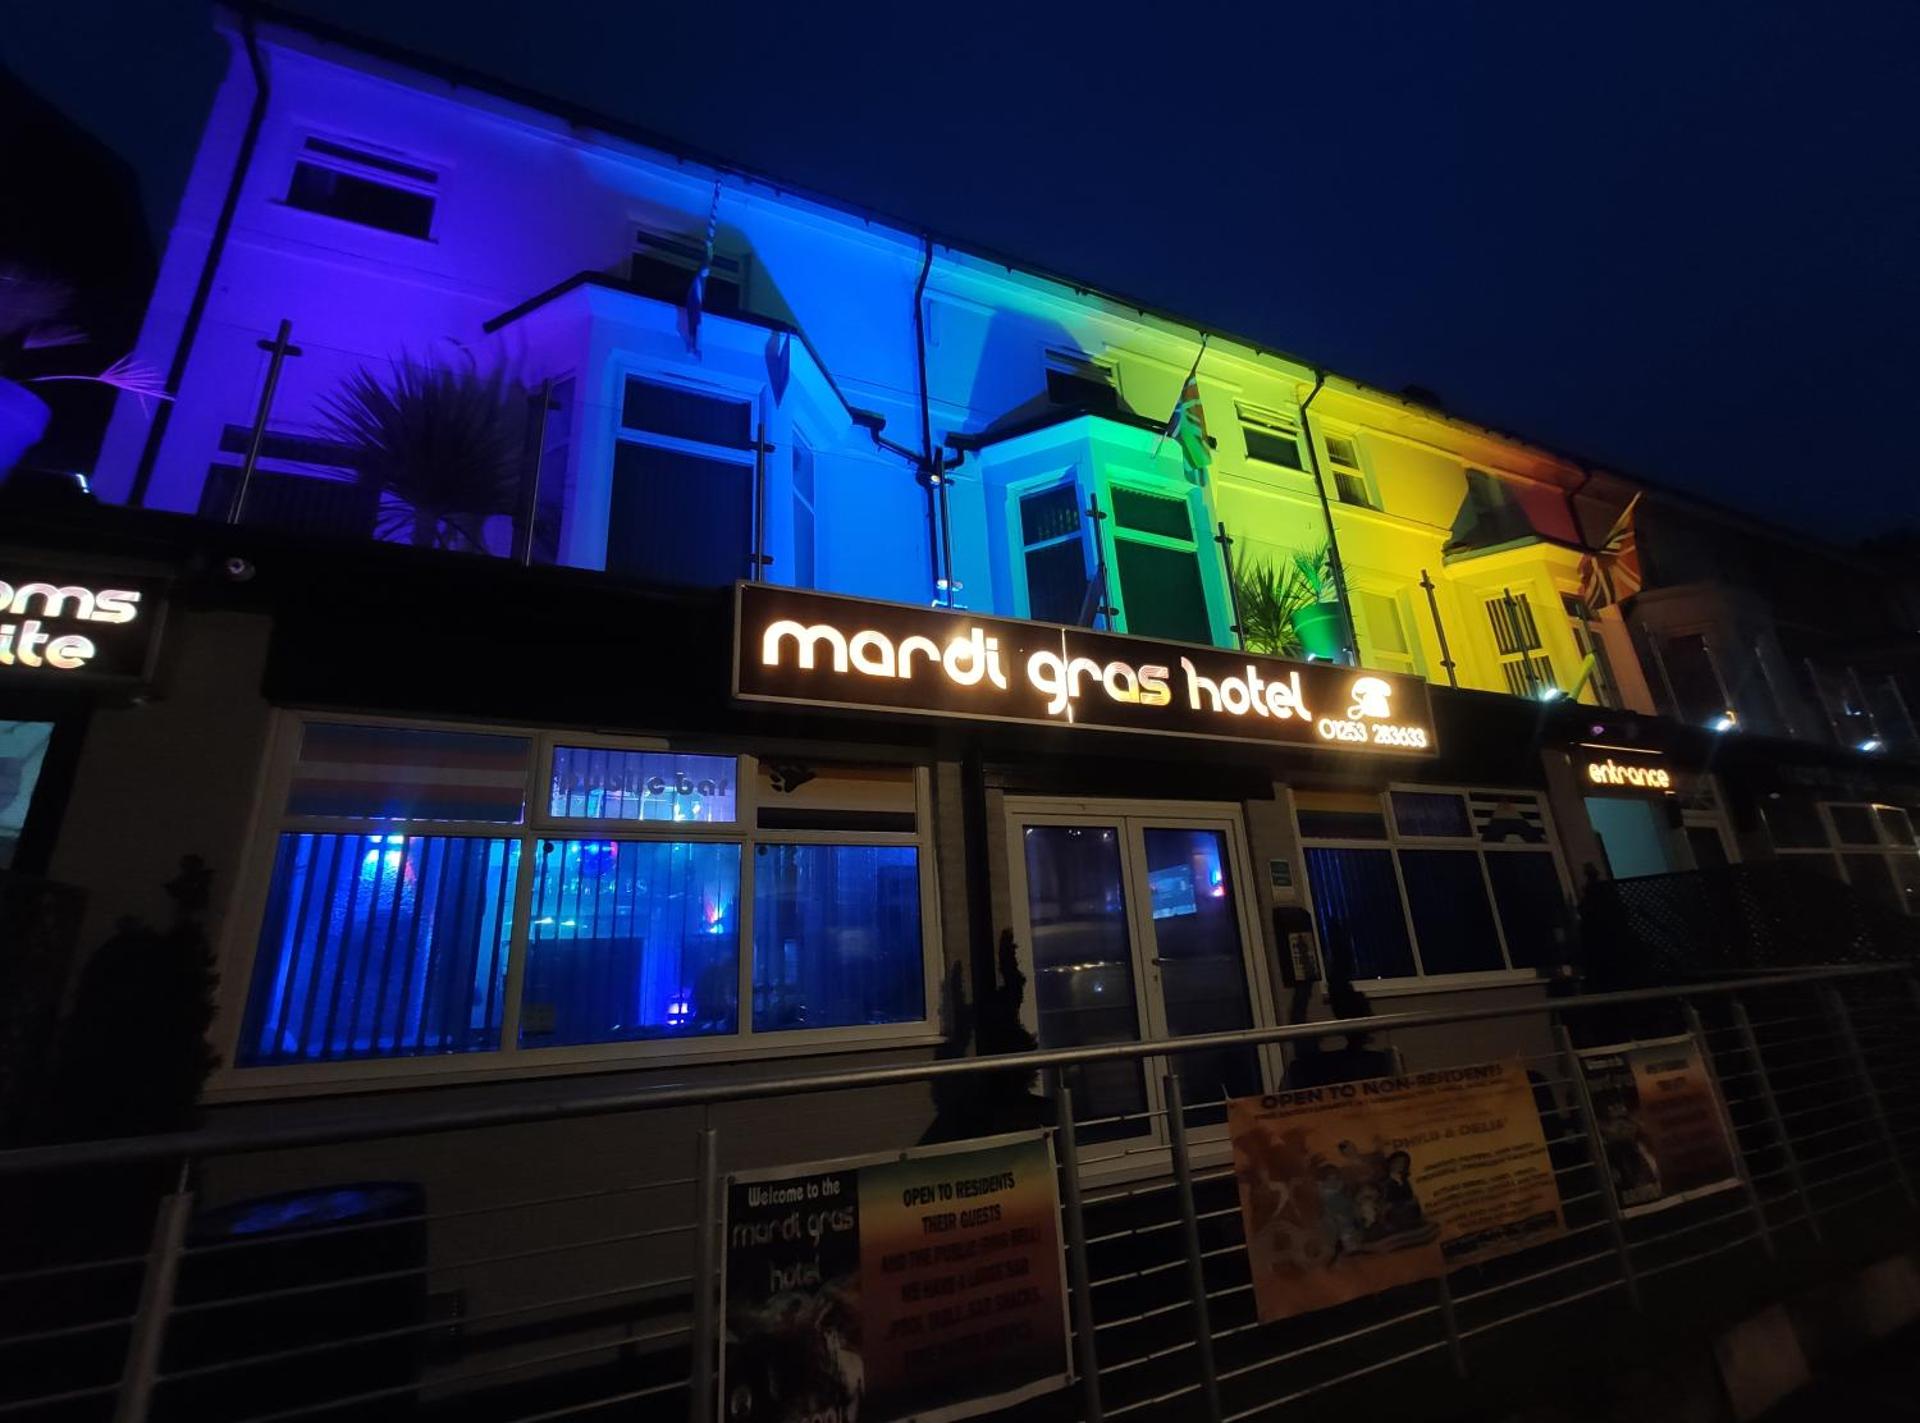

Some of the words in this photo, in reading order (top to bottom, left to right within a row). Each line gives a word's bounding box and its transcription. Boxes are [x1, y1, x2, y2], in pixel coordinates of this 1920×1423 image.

[763, 620, 1007, 690] mardi
[1027, 651, 1171, 715] gras
[1181, 656, 1312, 721] hotel
[1319, 719, 1368, 742] 01253
[1589, 759, 1670, 788] entrance
[1261, 1088, 1322, 1109] OPEN
[1329, 1084, 1356, 1099] TO
[748, 1184, 804, 1208] Welcome
[806, 1182, 819, 1199] to
[822, 1176, 840, 1197] the
[903, 1183, 935, 1207] OPEN
[938, 1181, 952, 1201] TO
[956, 1171, 1015, 1199] RESIDENTS
[732, 1211, 801, 1249] mardi
[807, 1205, 855, 1249] gras
[922, 1213, 956, 1234] THEIR
[961, 1203, 1001, 1228] GUESTS
